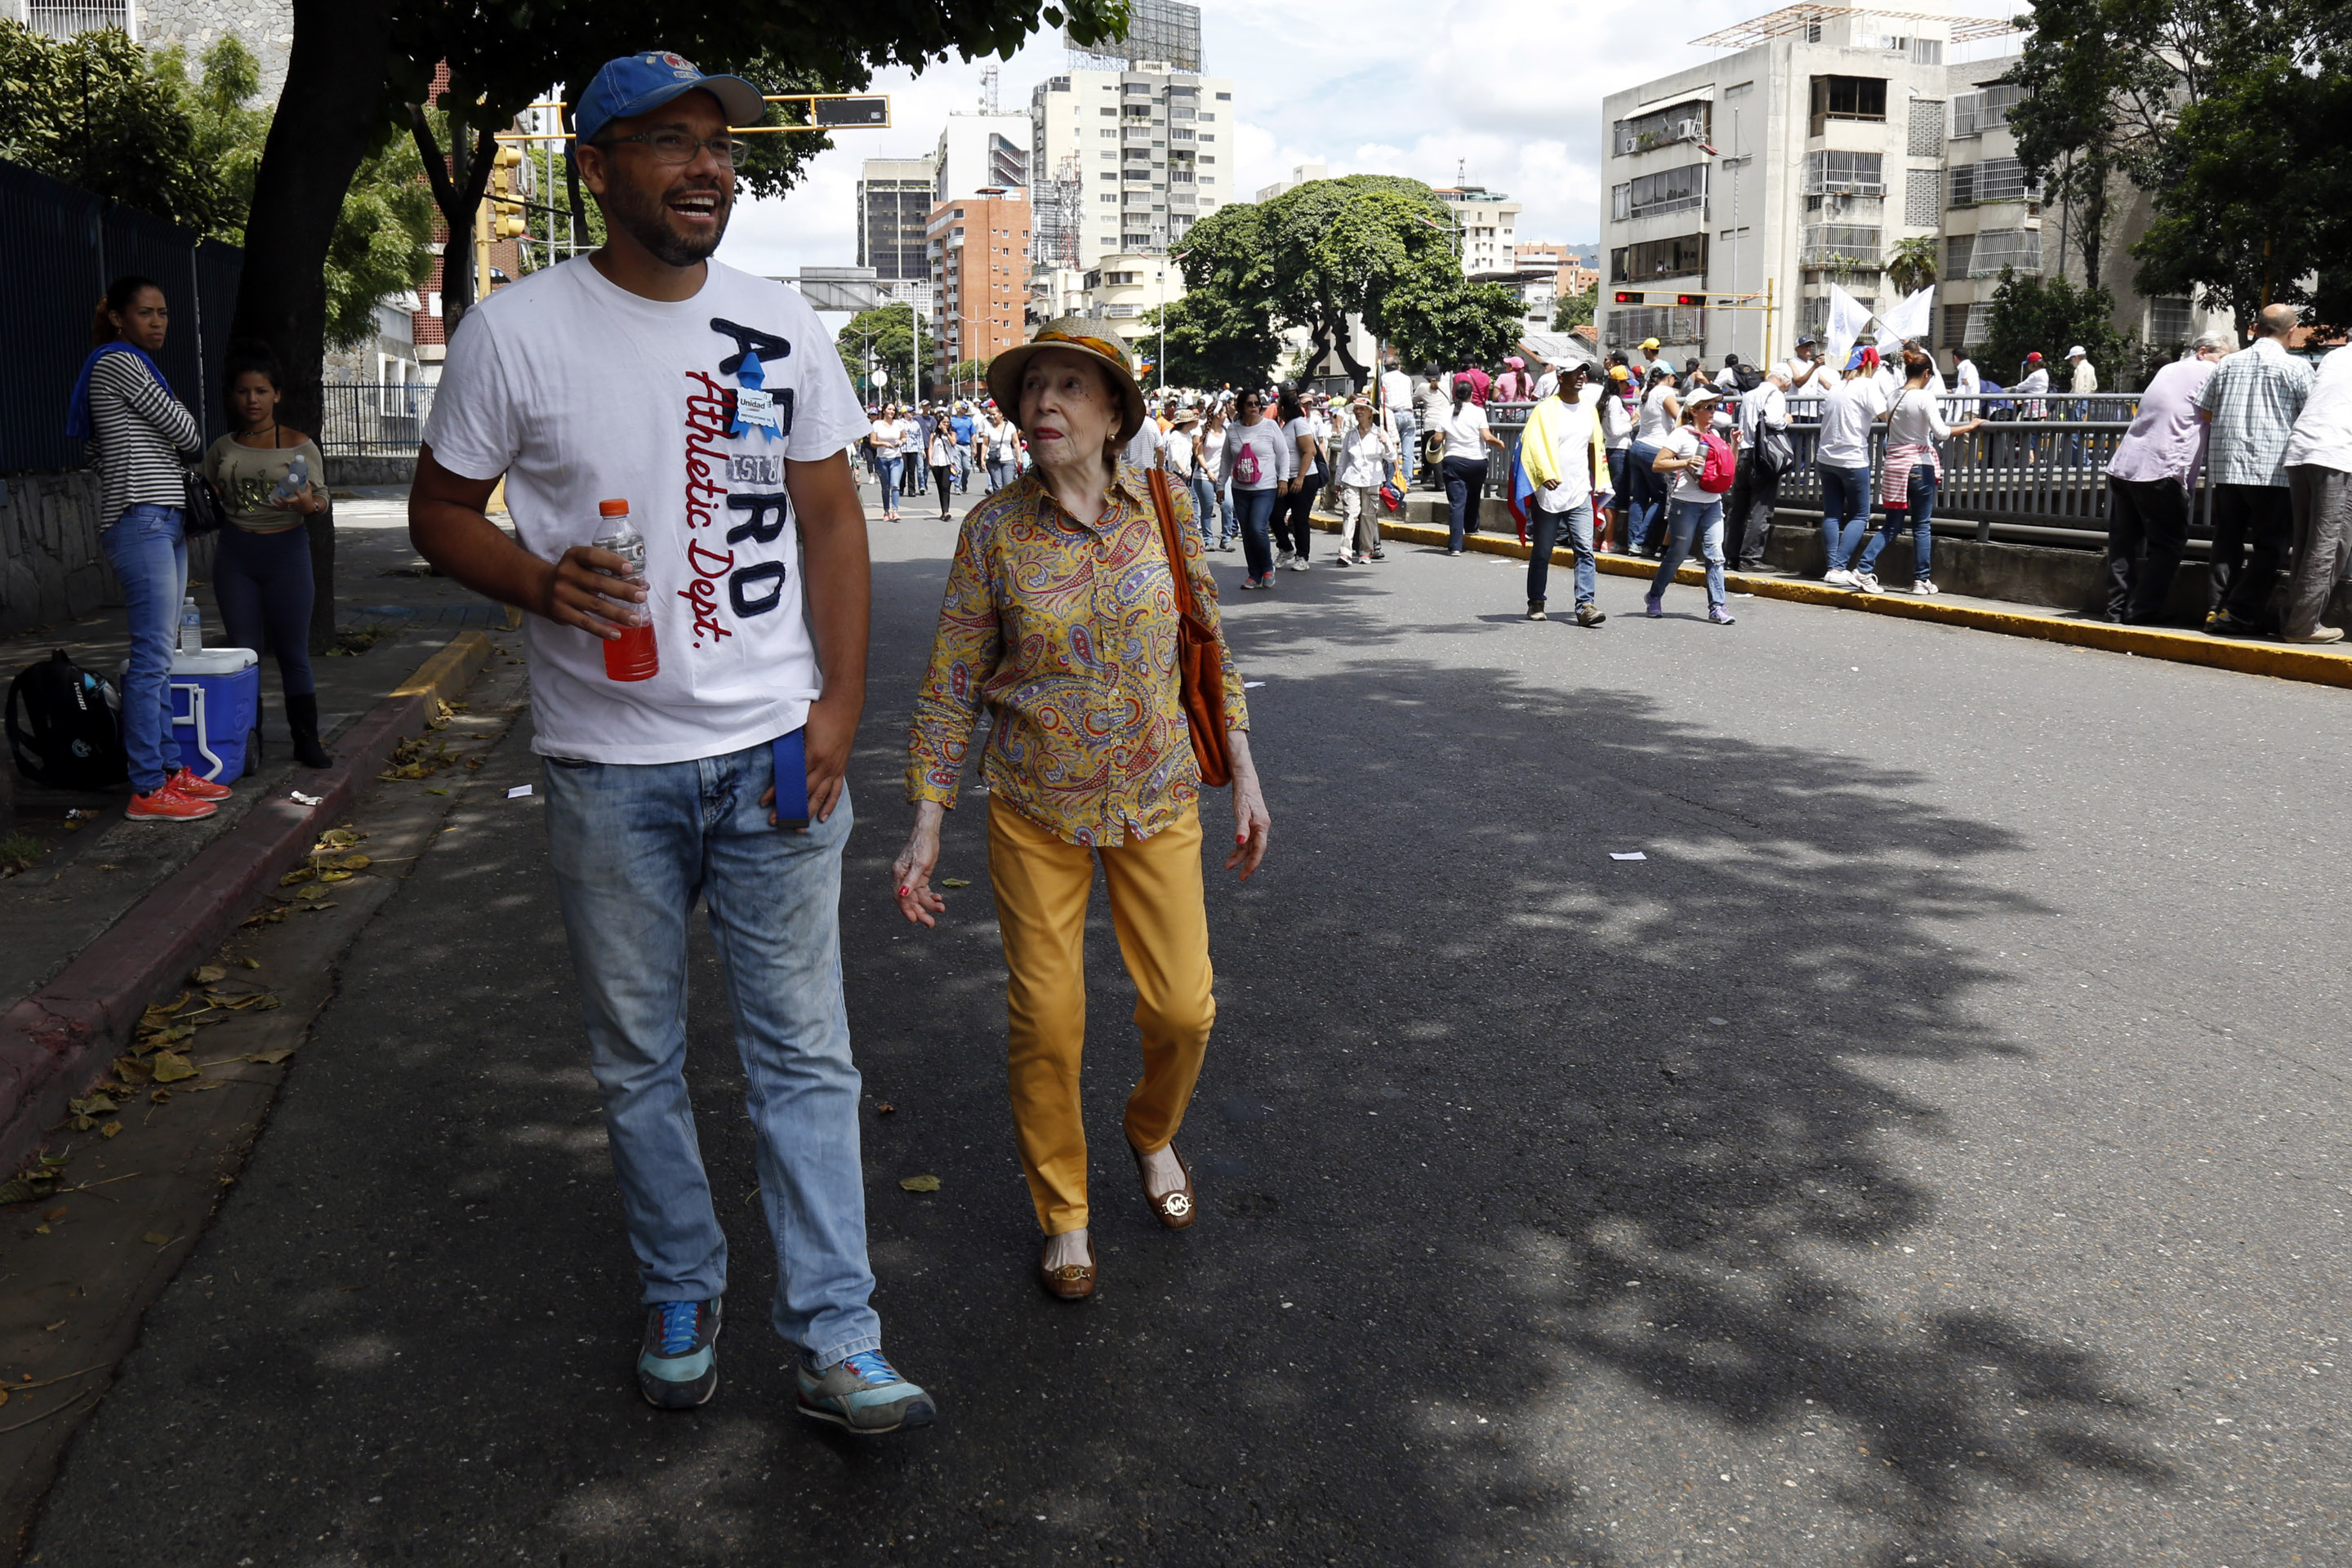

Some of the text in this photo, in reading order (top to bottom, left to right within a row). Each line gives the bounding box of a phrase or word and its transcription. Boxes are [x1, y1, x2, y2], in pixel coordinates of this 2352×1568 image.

[740, 398, 766, 409] Unidad
[732, 457, 764, 483] EST.
[677, 371, 735, 649] Athletic Dept.
